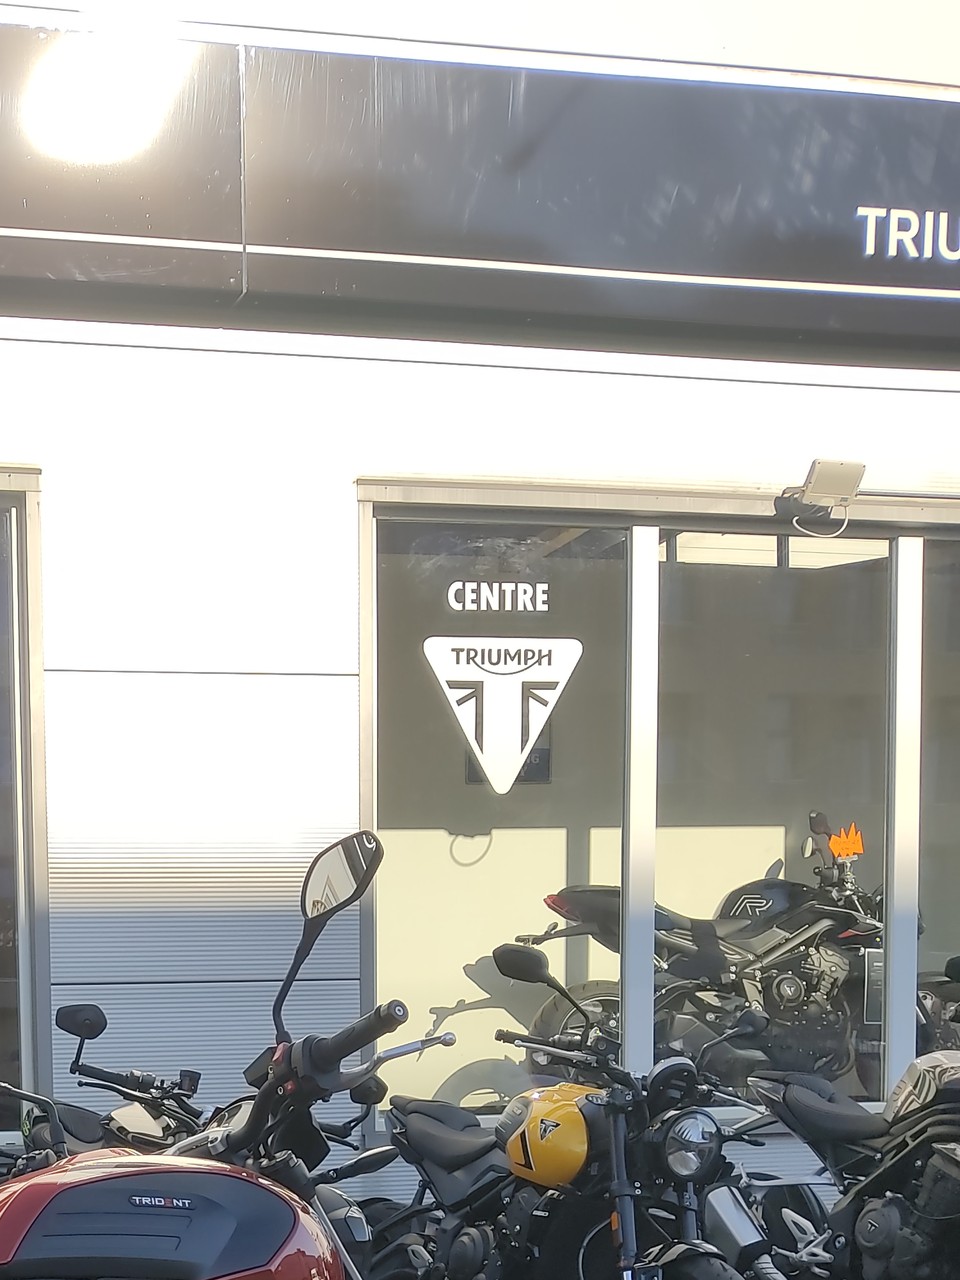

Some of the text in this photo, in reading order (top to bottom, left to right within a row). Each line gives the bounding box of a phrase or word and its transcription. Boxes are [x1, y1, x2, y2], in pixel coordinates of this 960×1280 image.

[447, 581, 550, 612] CENTRE
[451, 648, 552, 675] TRIUMPH
[131, 1196, 192, 1208] TRIDENT
